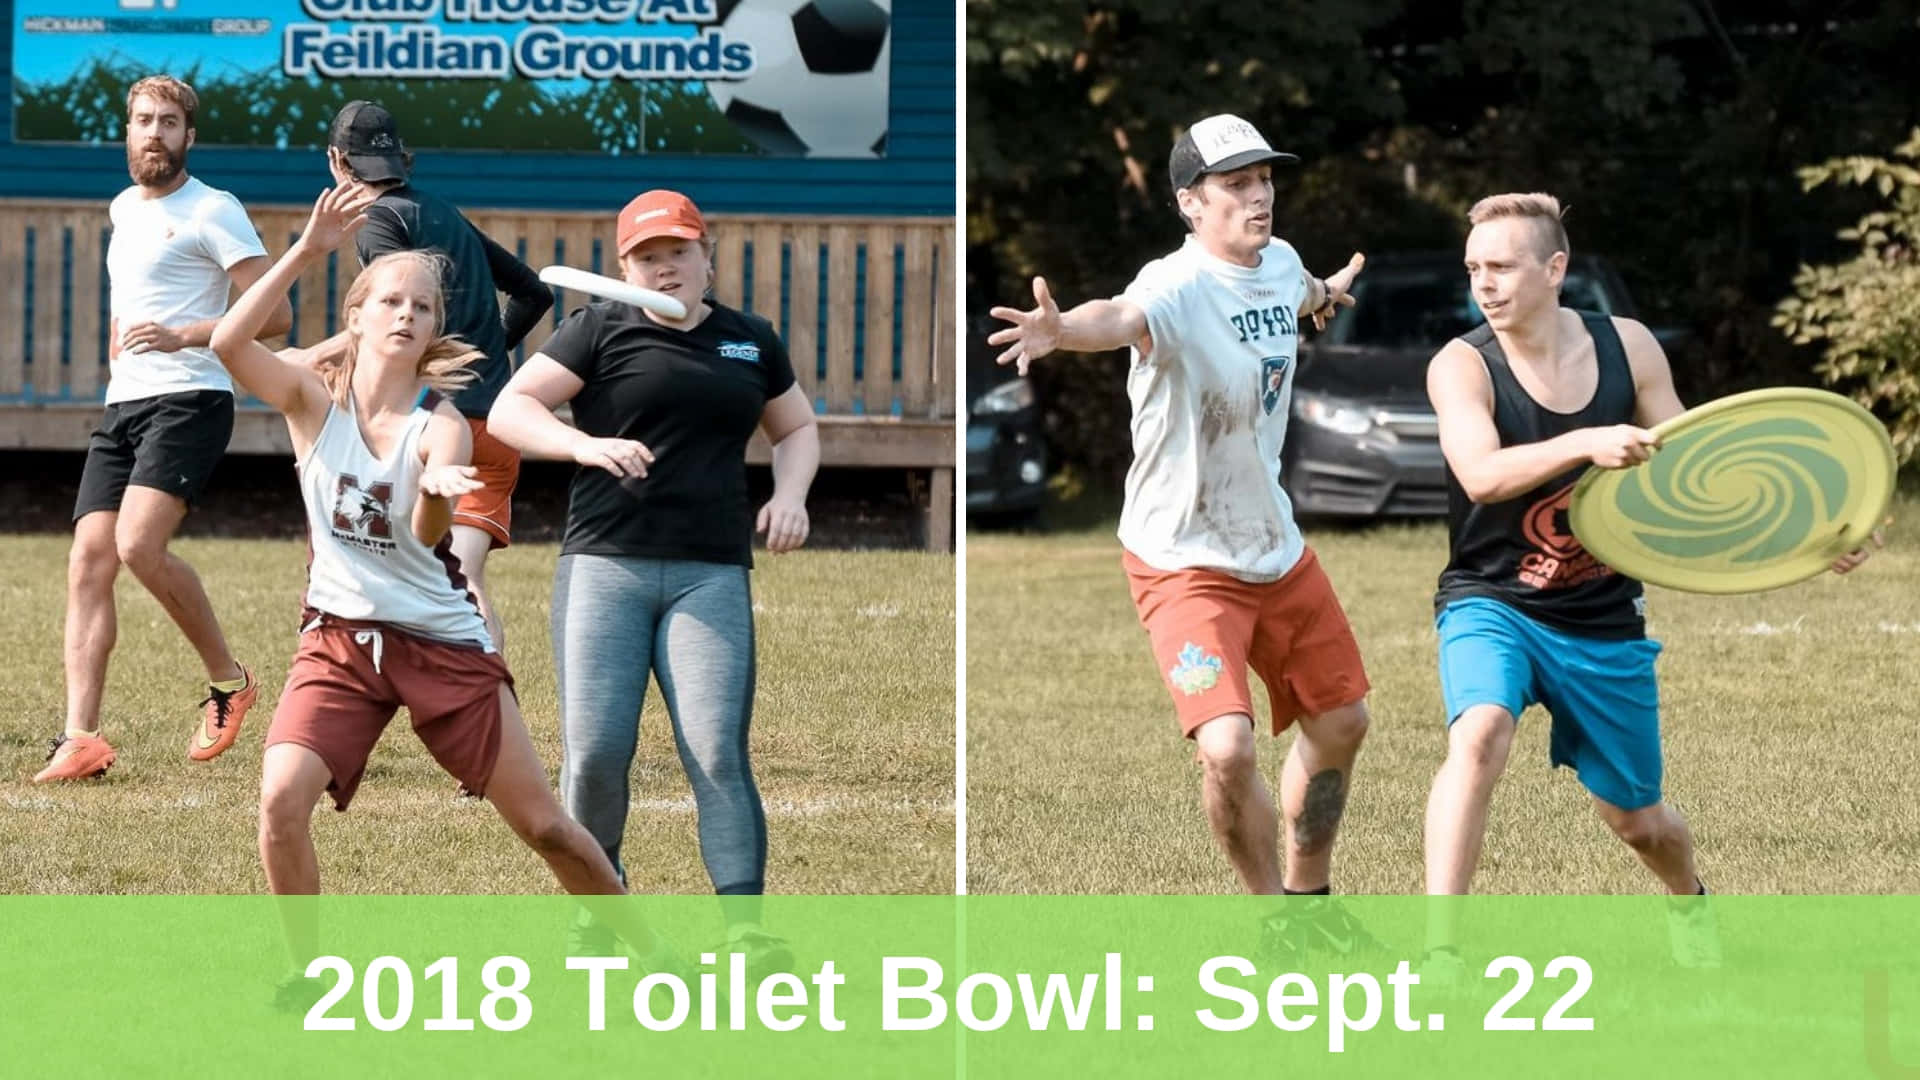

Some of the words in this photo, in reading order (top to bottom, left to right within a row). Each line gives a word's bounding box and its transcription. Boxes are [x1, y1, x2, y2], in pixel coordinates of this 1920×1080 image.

[212, 18, 271, 33] GROUP
[289, 27, 507, 72] Feildian
[517, 28, 754, 74] Grounds
